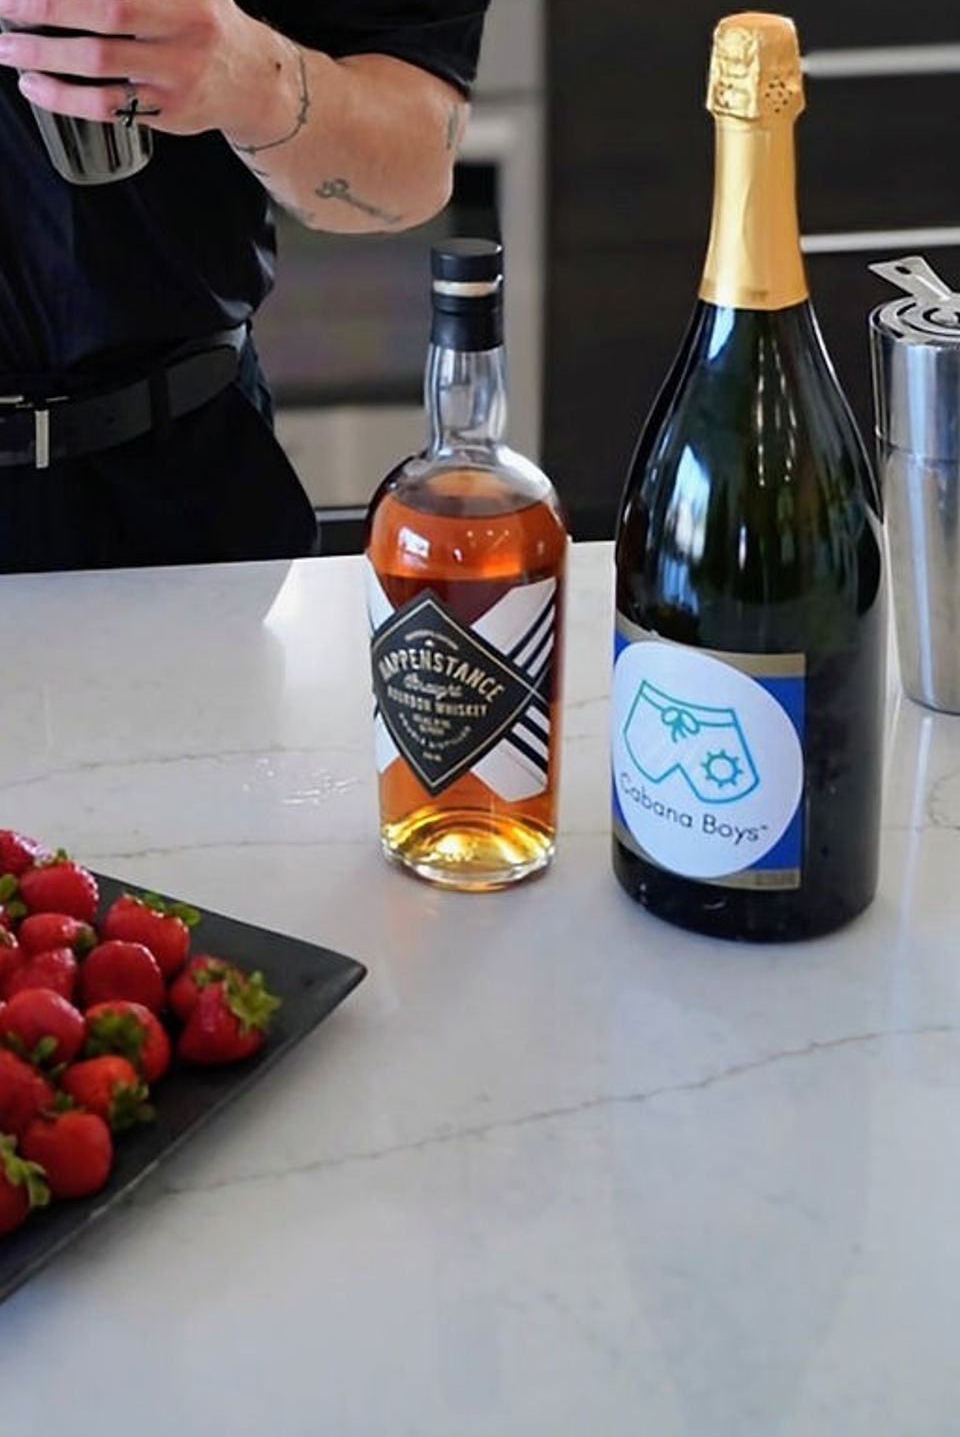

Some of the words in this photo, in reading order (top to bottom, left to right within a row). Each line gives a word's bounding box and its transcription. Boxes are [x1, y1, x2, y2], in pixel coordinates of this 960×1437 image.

[379, 648, 505, 703] HAPPENSTANCE
[387, 684, 432, 712] BOURBON
[434, 701, 488, 716] WHISKEY
[620, 771, 693, 828] Cabana
